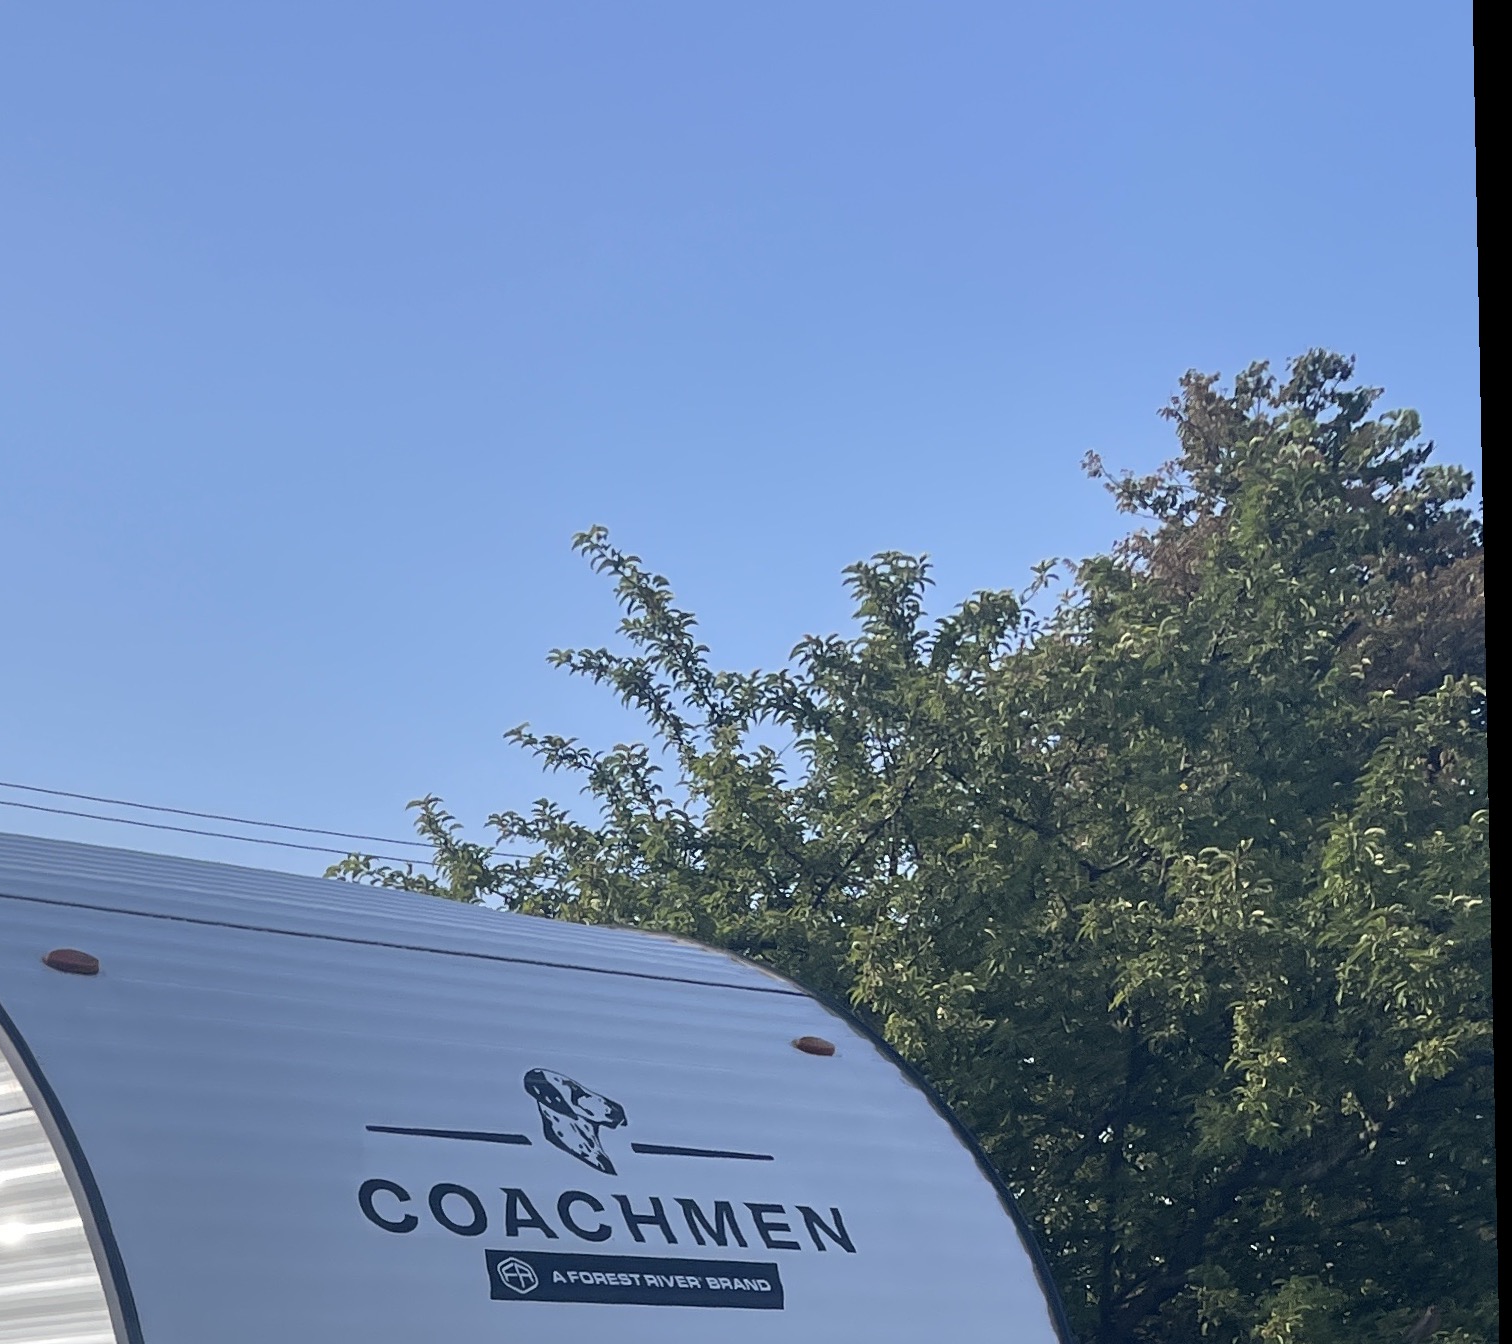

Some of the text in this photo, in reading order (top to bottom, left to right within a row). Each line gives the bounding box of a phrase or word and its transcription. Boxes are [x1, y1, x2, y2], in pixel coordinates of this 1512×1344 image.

[358, 1178, 857, 1254] COACHMEN
[552, 1270, 567, 1284] A
[570, 1271, 641, 1287] FOREST
[708, 1277, 772, 1292] BRAND
